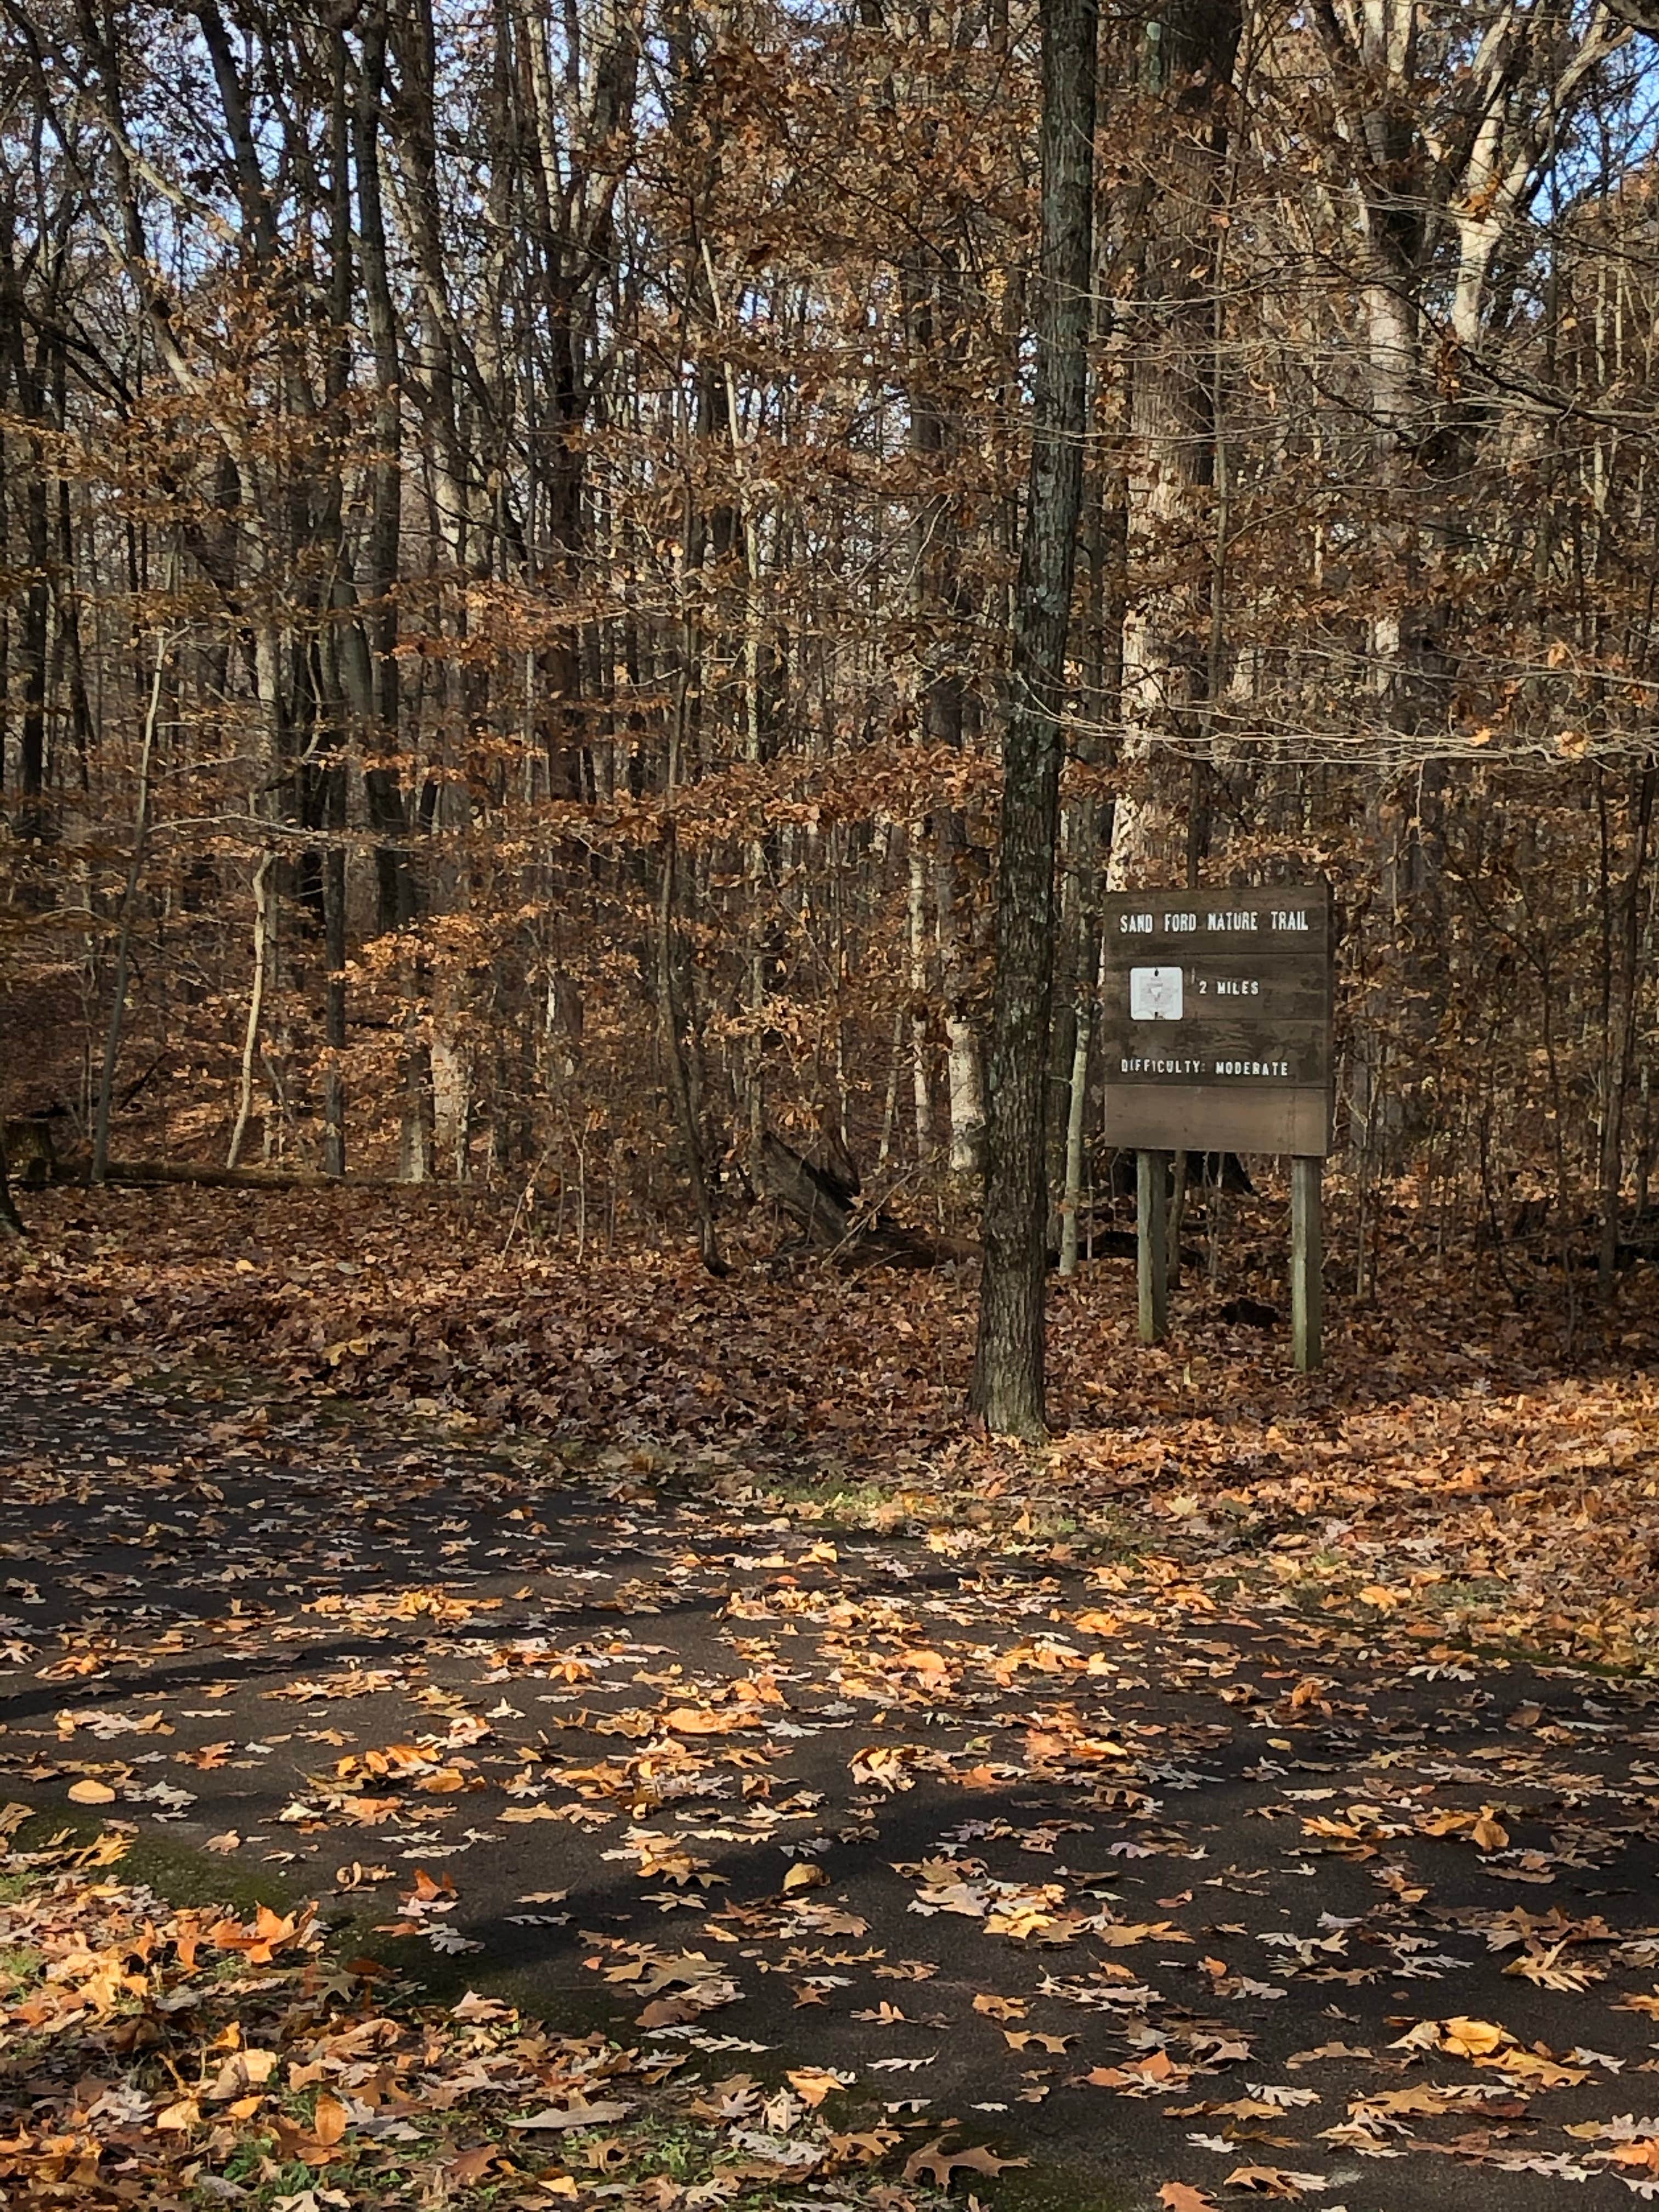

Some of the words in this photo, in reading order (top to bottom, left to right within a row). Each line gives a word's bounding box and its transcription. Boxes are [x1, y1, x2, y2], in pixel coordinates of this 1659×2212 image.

[1120, 914, 1153, 933] SAND
[1164, 913, 1197, 932] FORD
[1207, 911, 1259, 931] NATURE
[1271, 911, 1308, 930] TRAIL
[1199, 980, 1207, 994] 2
[1217, 981, 1259, 995] MILES
[1216, 1062, 1288, 1076] MODERATE
